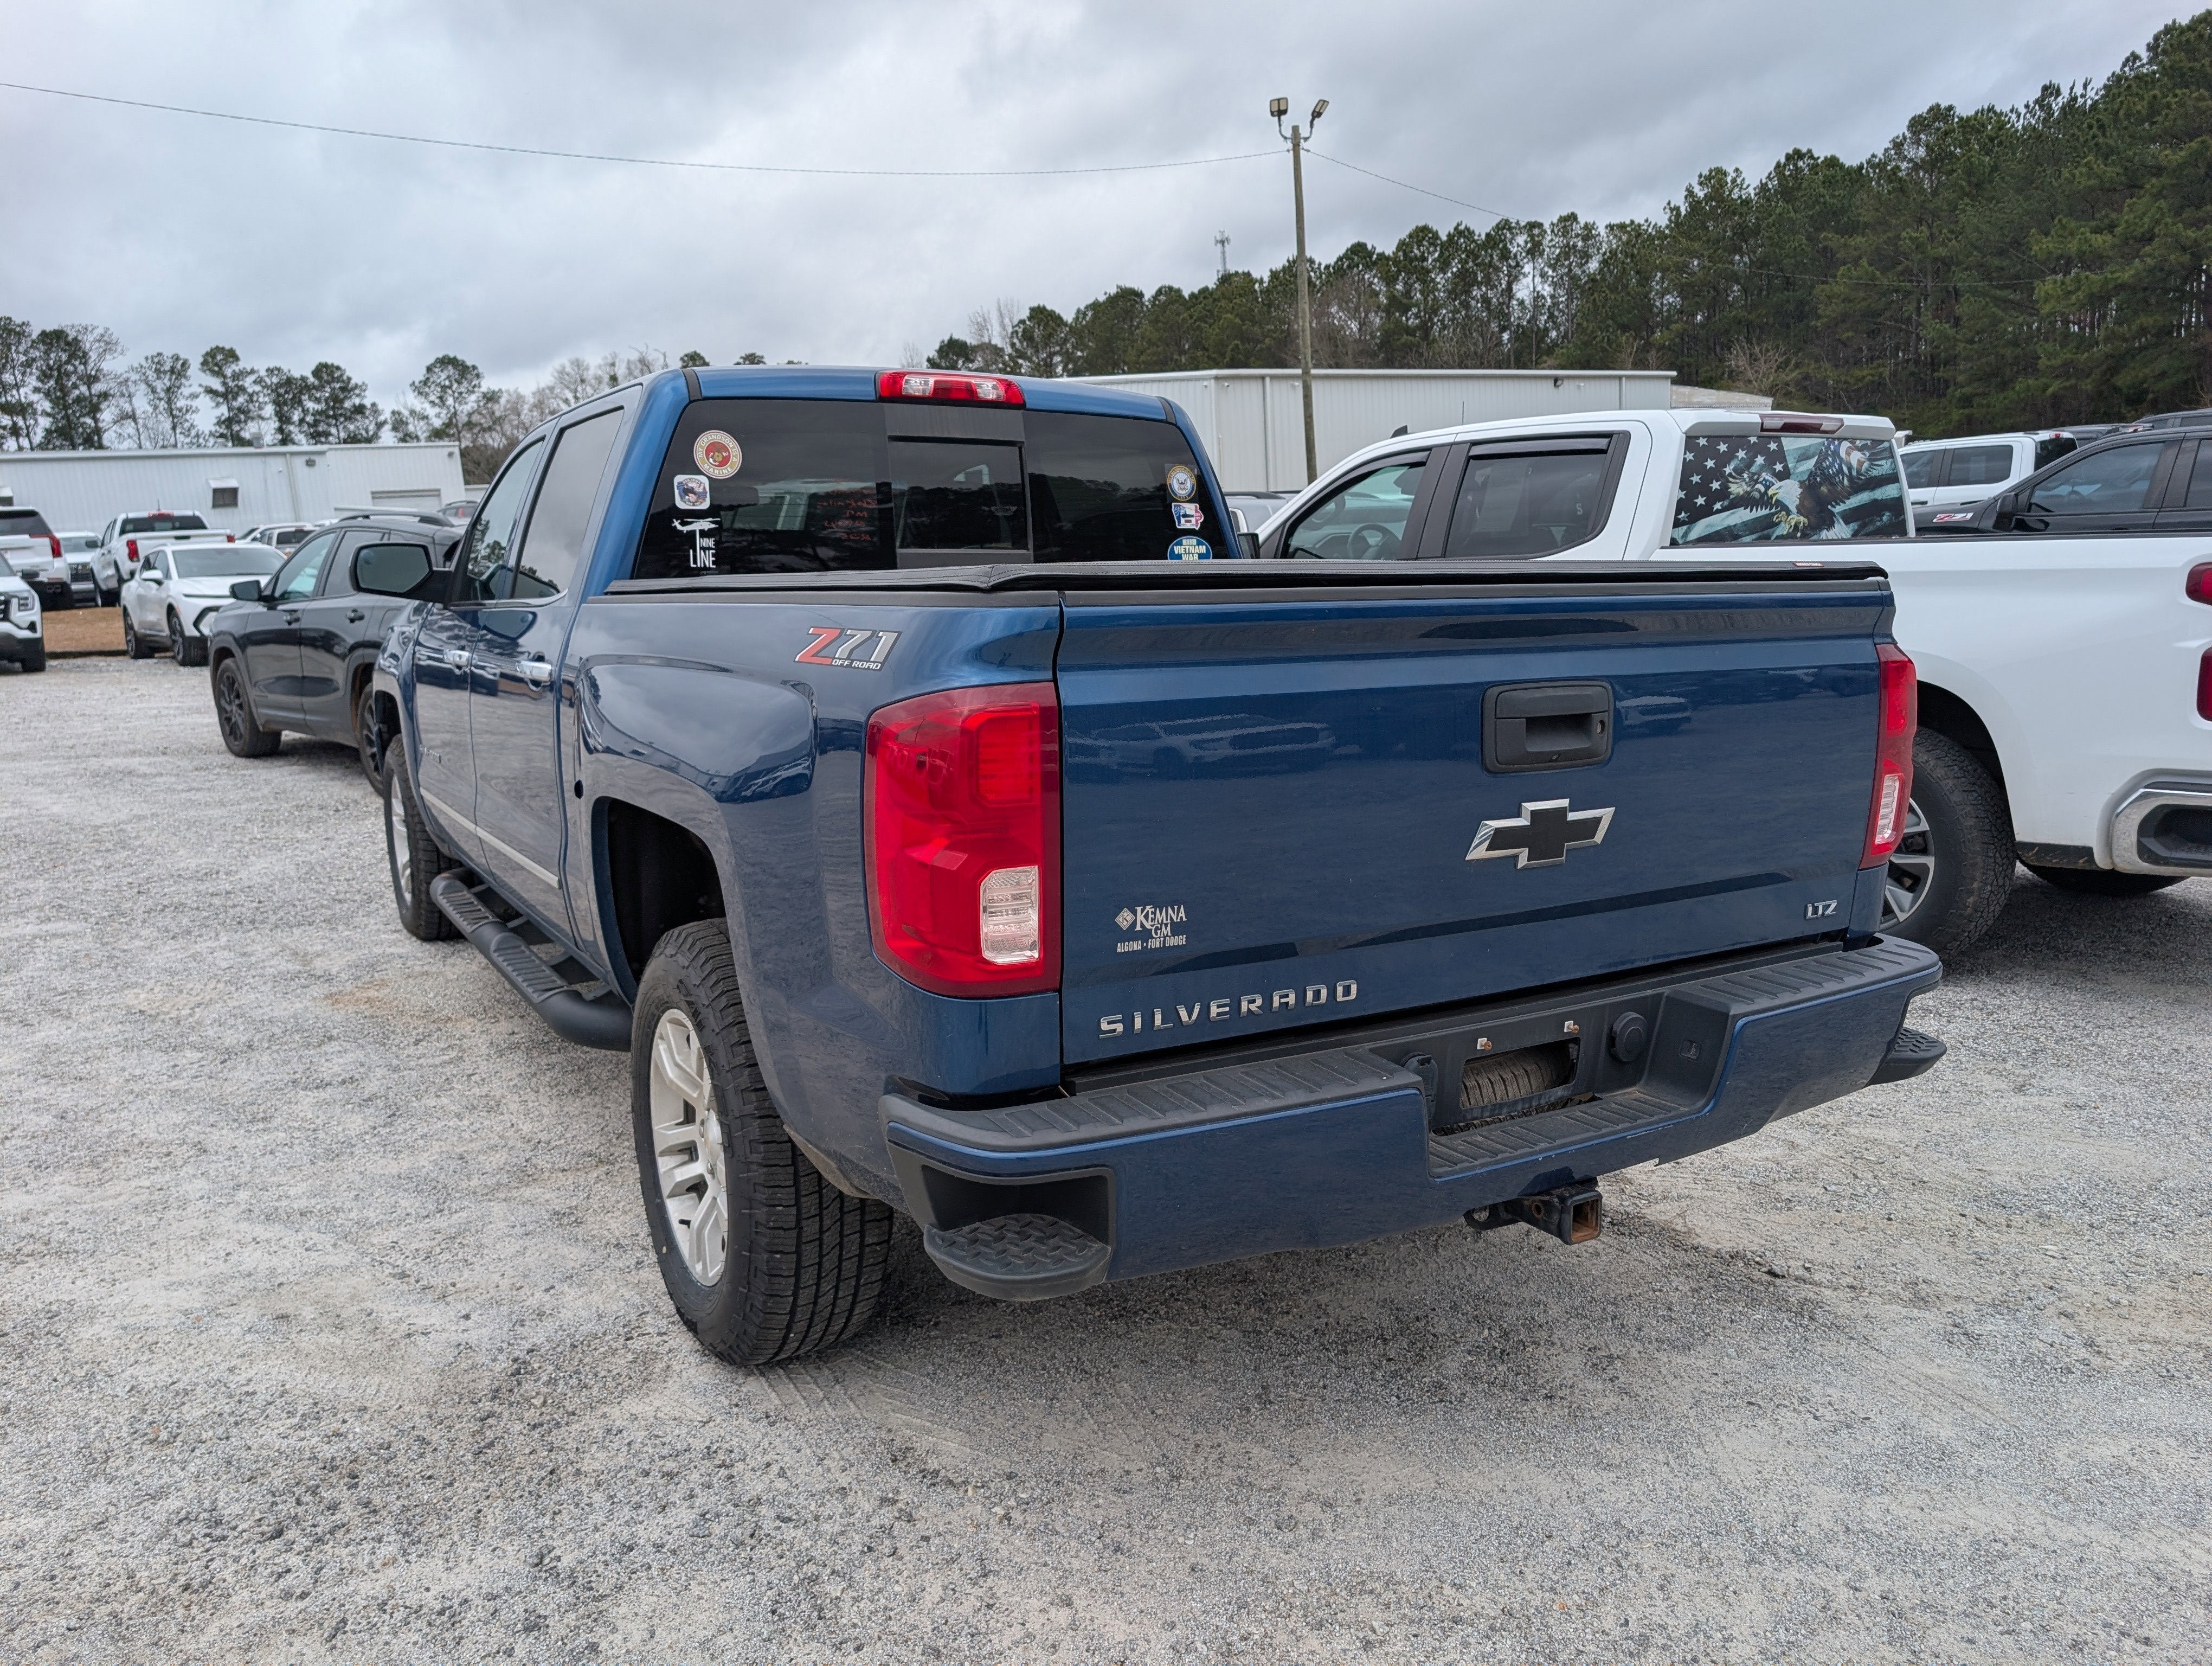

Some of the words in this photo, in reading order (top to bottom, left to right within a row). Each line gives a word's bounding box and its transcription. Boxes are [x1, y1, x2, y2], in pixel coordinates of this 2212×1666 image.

[700, 434, 734, 447] GRANDSON
[698, 447, 703, 458] MY
[704, 464, 732, 475] MARINE
[1933, 512, 1974, 522] Z71
[700, 537, 716, 548] NINE
[1173, 545, 1206, 554] VIETNAM
[690, 549, 716, 568] LINE
[794, 626, 903, 666] Z71
[852, 661, 882, 670] ROAD
[1805, 900, 1837, 920] LTZ
[1134, 905, 1187, 931] KEMNA
[1152, 922, 1172, 938] GM
[1116, 940, 1142, 953] ALGONA
[1148, 937, 1164, 949] FORT
[1165, 934, 1186, 947] DODGE
[1098, 979, 1357, 1039] SILVERADO
